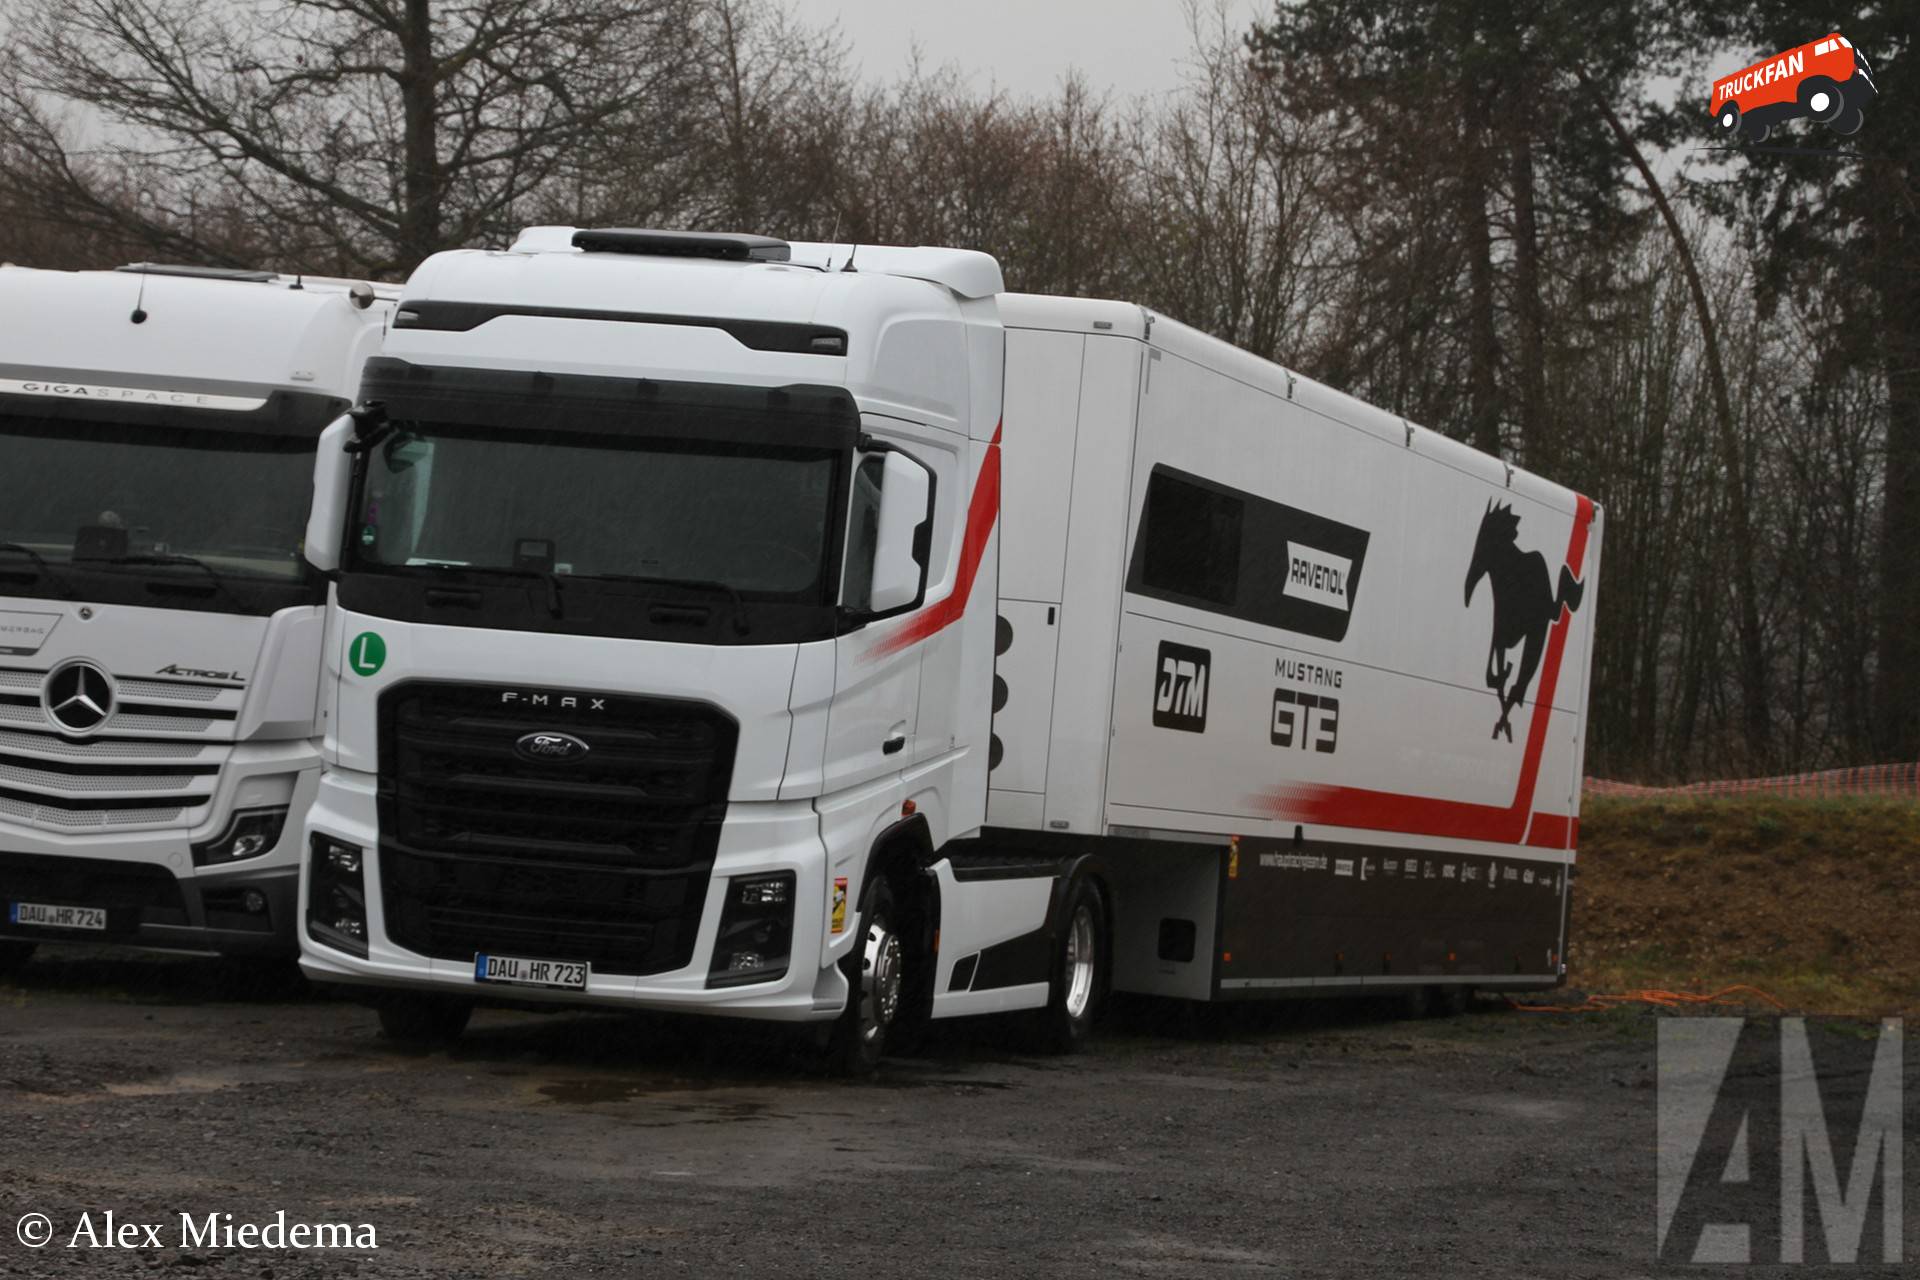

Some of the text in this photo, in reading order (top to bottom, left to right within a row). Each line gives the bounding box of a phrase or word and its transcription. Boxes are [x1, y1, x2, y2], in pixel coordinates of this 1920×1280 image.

[1291, 557, 1343, 596] RAVENOL
[358, 636, 376, 669] L
[1156, 656, 1206, 718] DTM
[1275, 657, 1342, 689] MUSTANG
[501, 692, 605, 710] F-MAX
[1270, 687, 1340, 754] GT3
[530, 736, 572, 755] Ford
[20, 904, 103, 927] DAU HR 724
[488, 958, 584, 984] DAU HR 723
